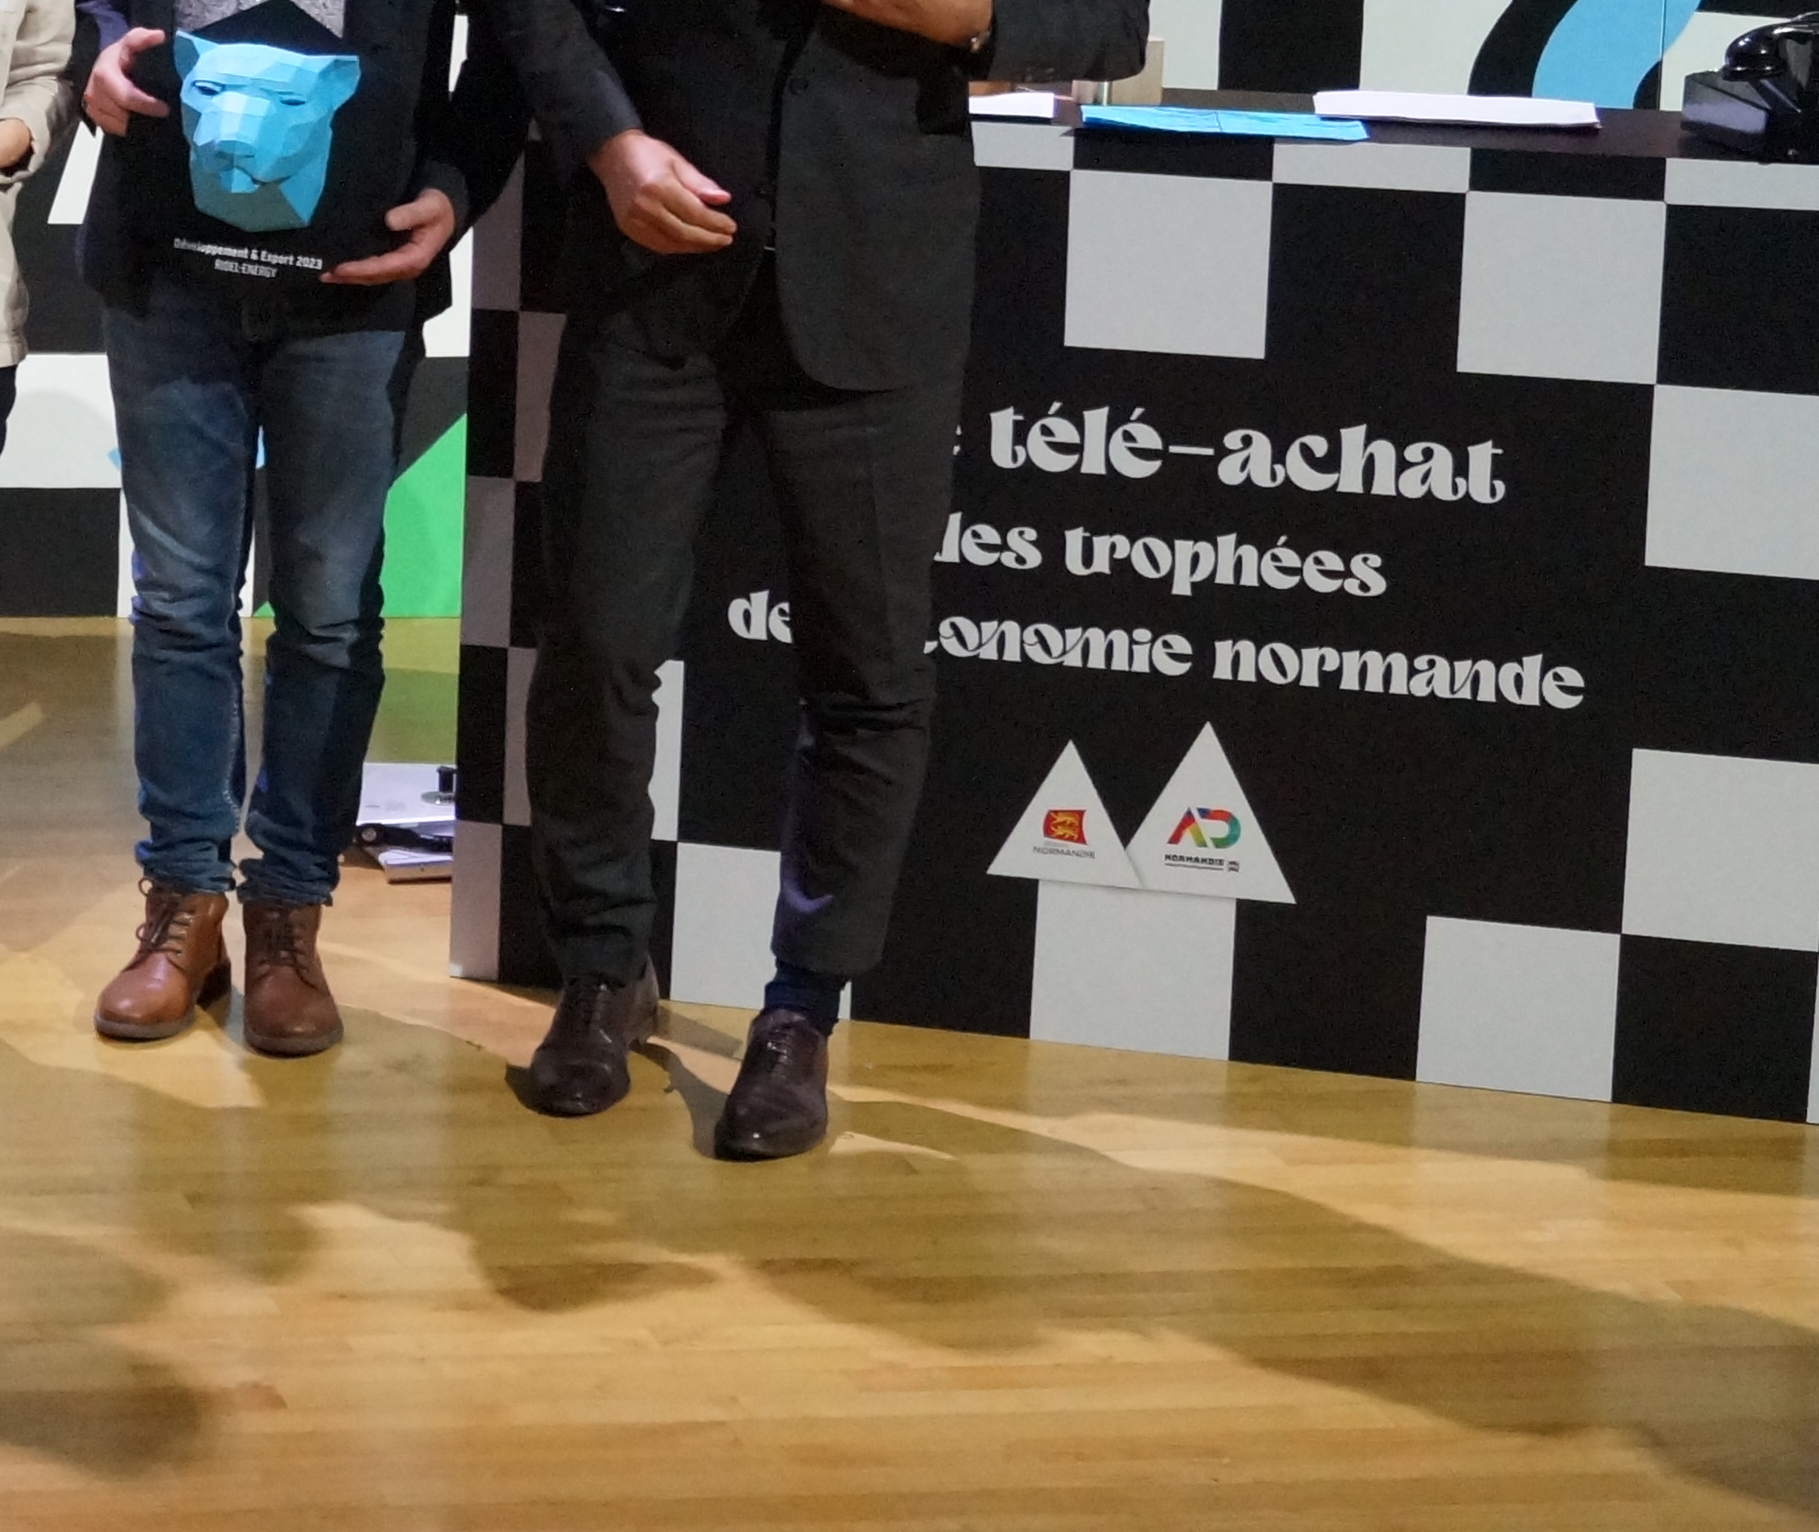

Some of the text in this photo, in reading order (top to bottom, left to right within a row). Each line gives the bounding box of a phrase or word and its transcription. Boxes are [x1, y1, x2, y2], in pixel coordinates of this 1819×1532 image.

[250, 249, 259, 261] &
[260, 250, 295, 267] Export
[295, 256, 324, 271] 2023
[990, 402, 1505, 503] télé-achat
[1065, 527, 1386, 596] trophées
[924, 617, 1192, 675] onomie
[1213, 640, 1584, 709] normande
[1032, 845, 1095, 859] NORMANDIE
[1164, 853, 1225, 866] NORMANDIE
